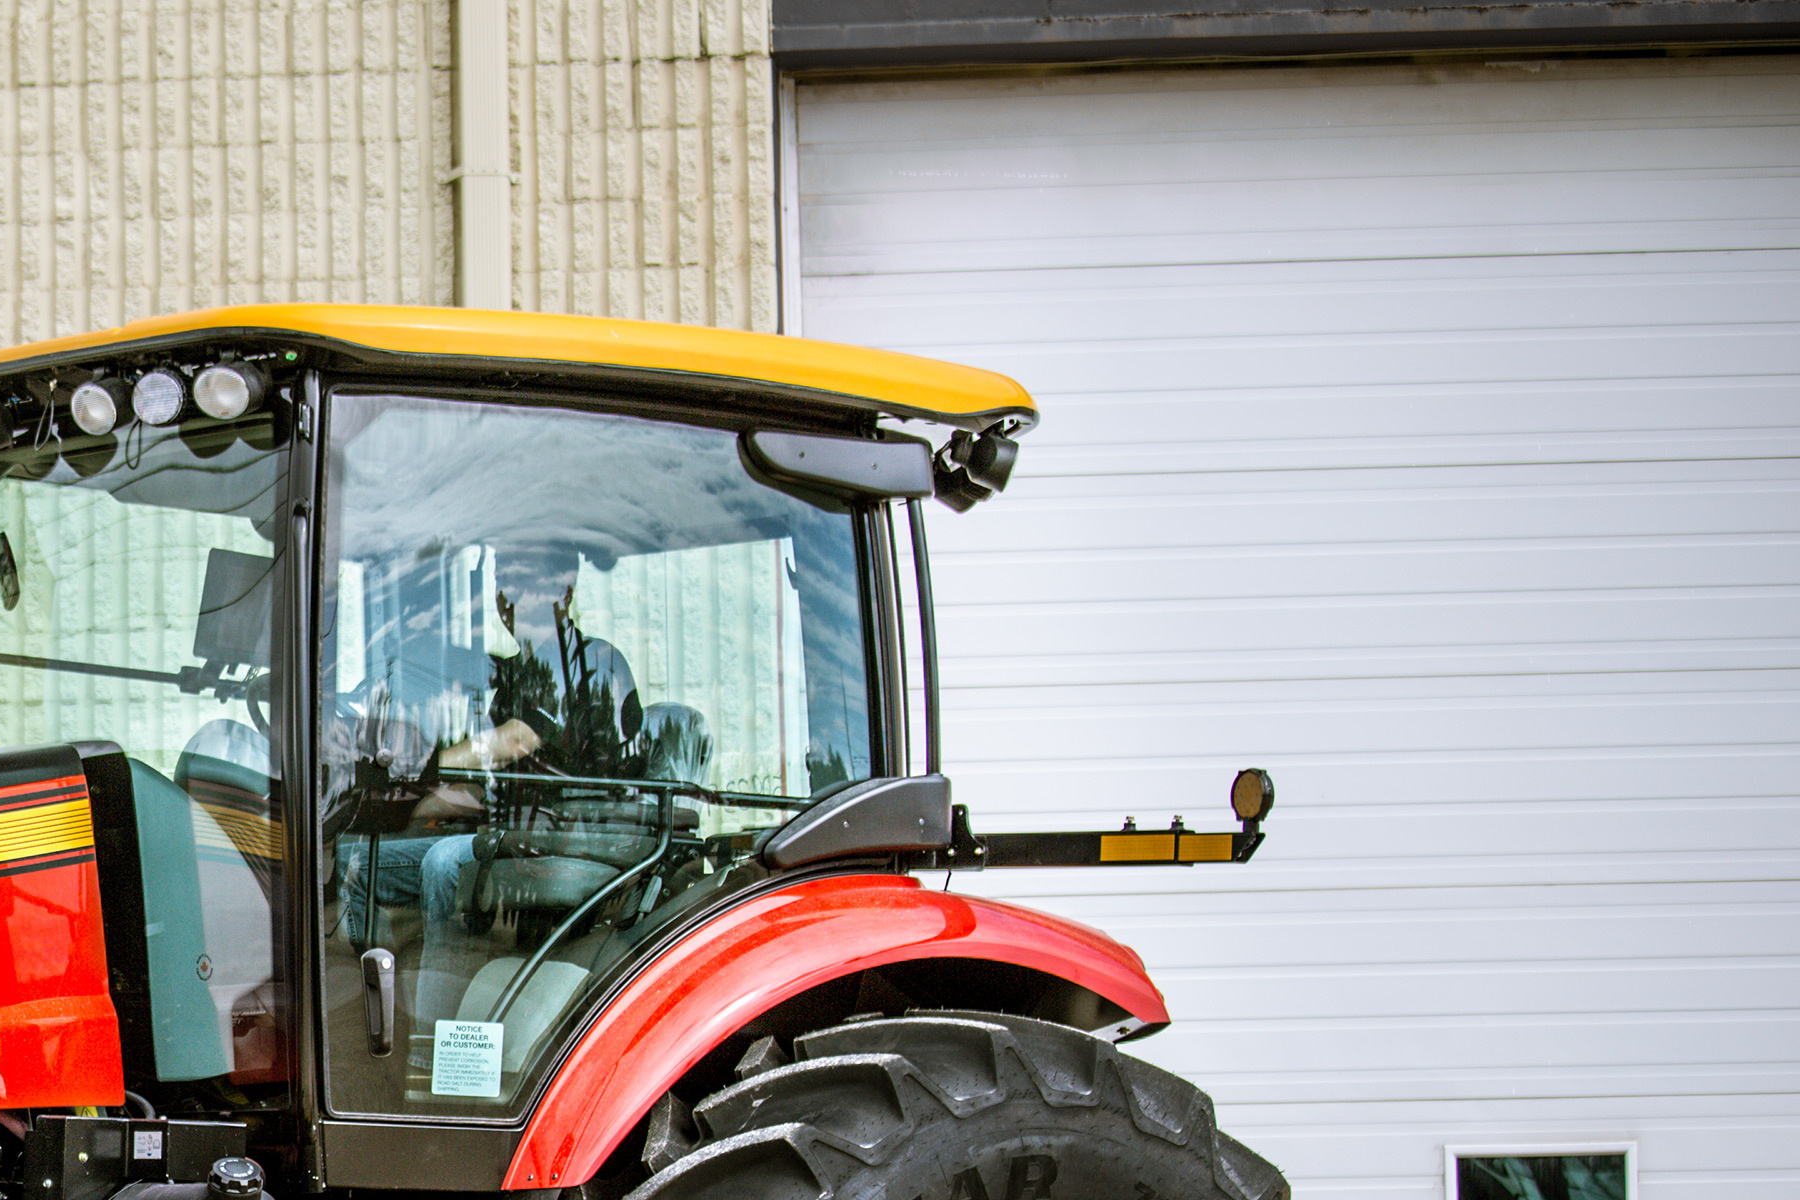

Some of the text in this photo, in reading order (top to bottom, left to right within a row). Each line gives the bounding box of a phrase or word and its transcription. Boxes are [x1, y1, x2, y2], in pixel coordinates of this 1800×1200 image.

[460, 1033, 489, 1041] DEALER
[440, 1040, 496, 1050] OR CUSTOMER:
